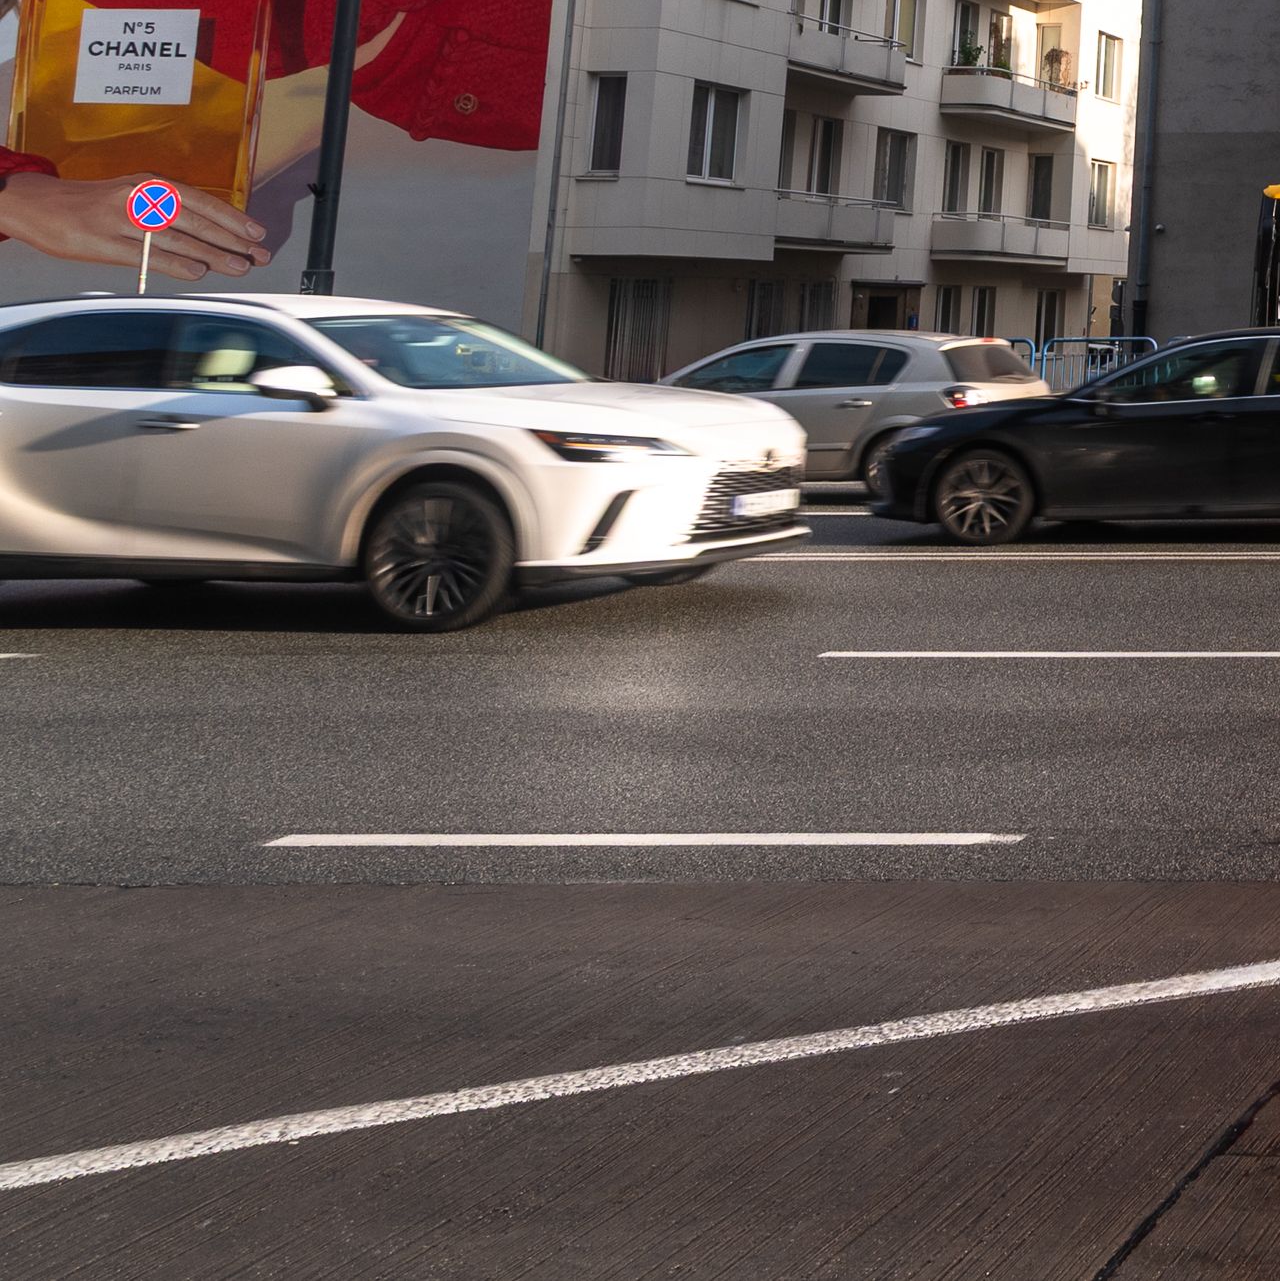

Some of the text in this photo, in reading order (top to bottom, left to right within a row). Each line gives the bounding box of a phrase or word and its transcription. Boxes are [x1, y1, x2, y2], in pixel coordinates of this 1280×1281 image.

[88, 40, 187, 58] CHANEL
[118, 63, 152, 71] PARIS
[104, 85, 162, 96] PARFUM
